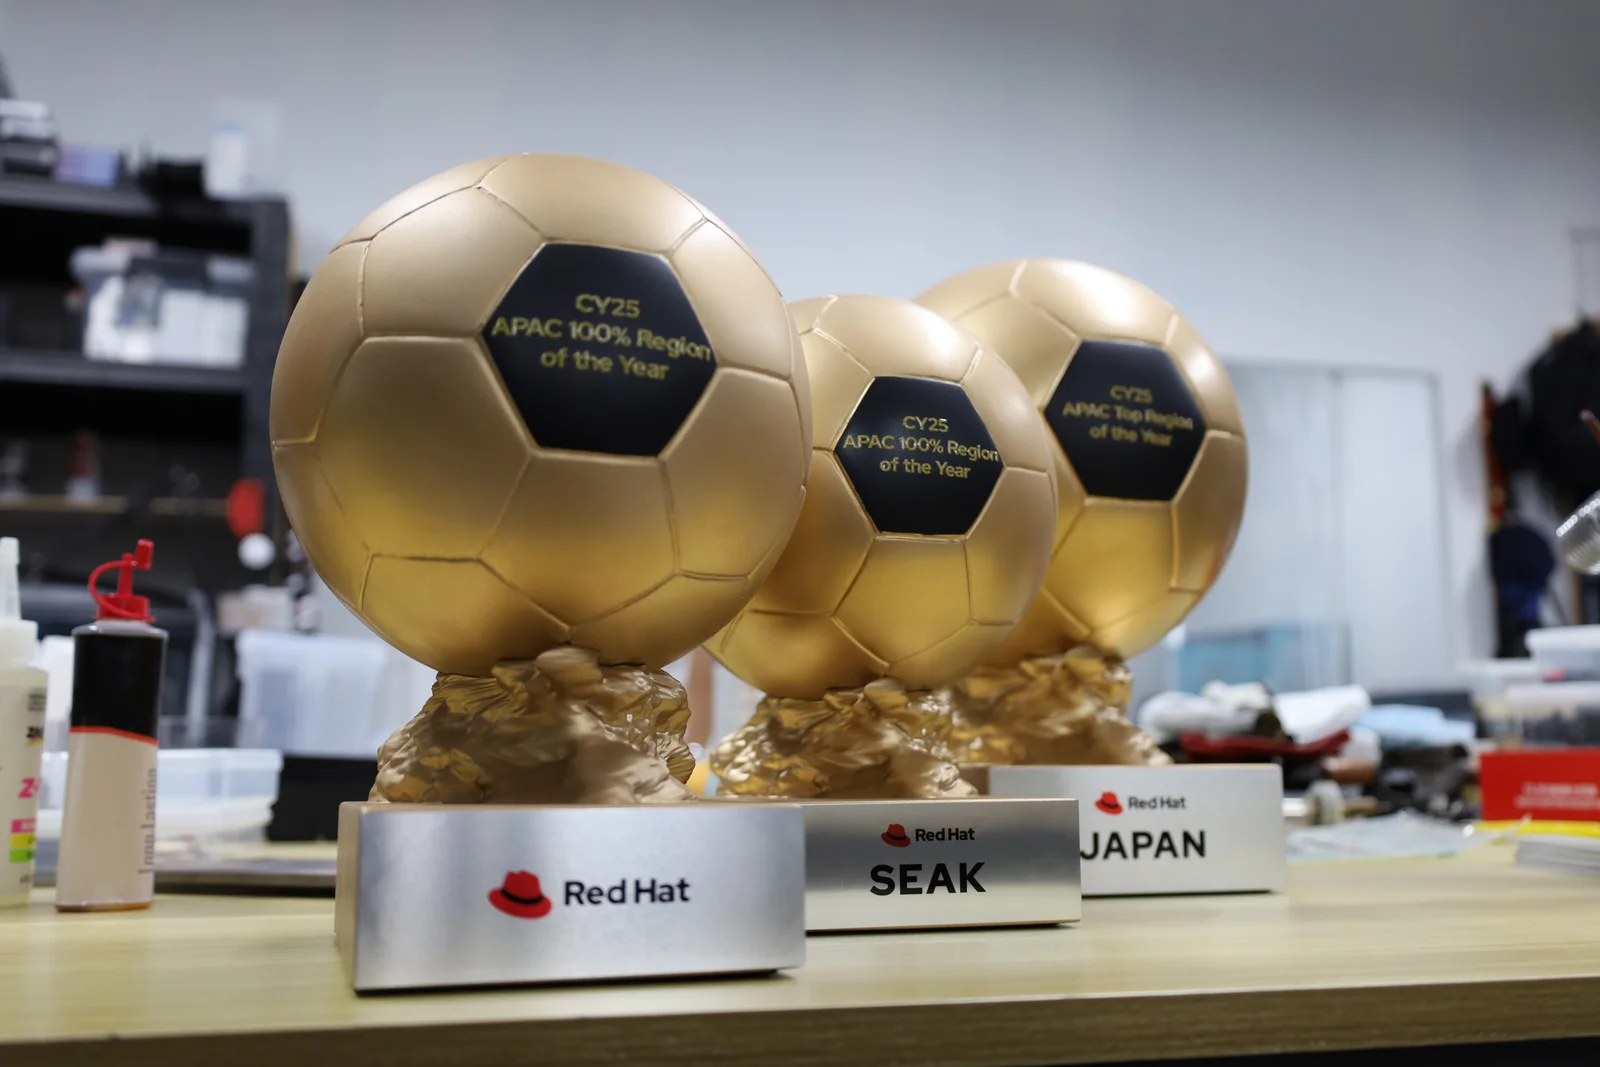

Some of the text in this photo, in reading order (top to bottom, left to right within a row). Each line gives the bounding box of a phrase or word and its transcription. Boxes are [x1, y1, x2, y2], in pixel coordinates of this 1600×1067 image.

[575, 294, 641, 318] CY25
[491, 316, 711, 361] APAC 100% Region
[540, 347, 670, 380] of the Year
[1110, 385, 1153, 404] CY25
[902, 415, 949, 433] CY25
[1062, 402, 1194, 431] APAC Top Region
[843, 434, 999, 462] APAC 100% Region
[1089, 424, 1173, 447] of the Year
[879, 457, 971, 479] of the Year
[1128, 796, 1186, 809] Red Hat
[915, 827, 975, 842] Red Hat
[1080, 830, 1206, 860] JAPAN
[564, 878, 690, 906] Red Hat
[870, 862, 987, 896] SEAK
